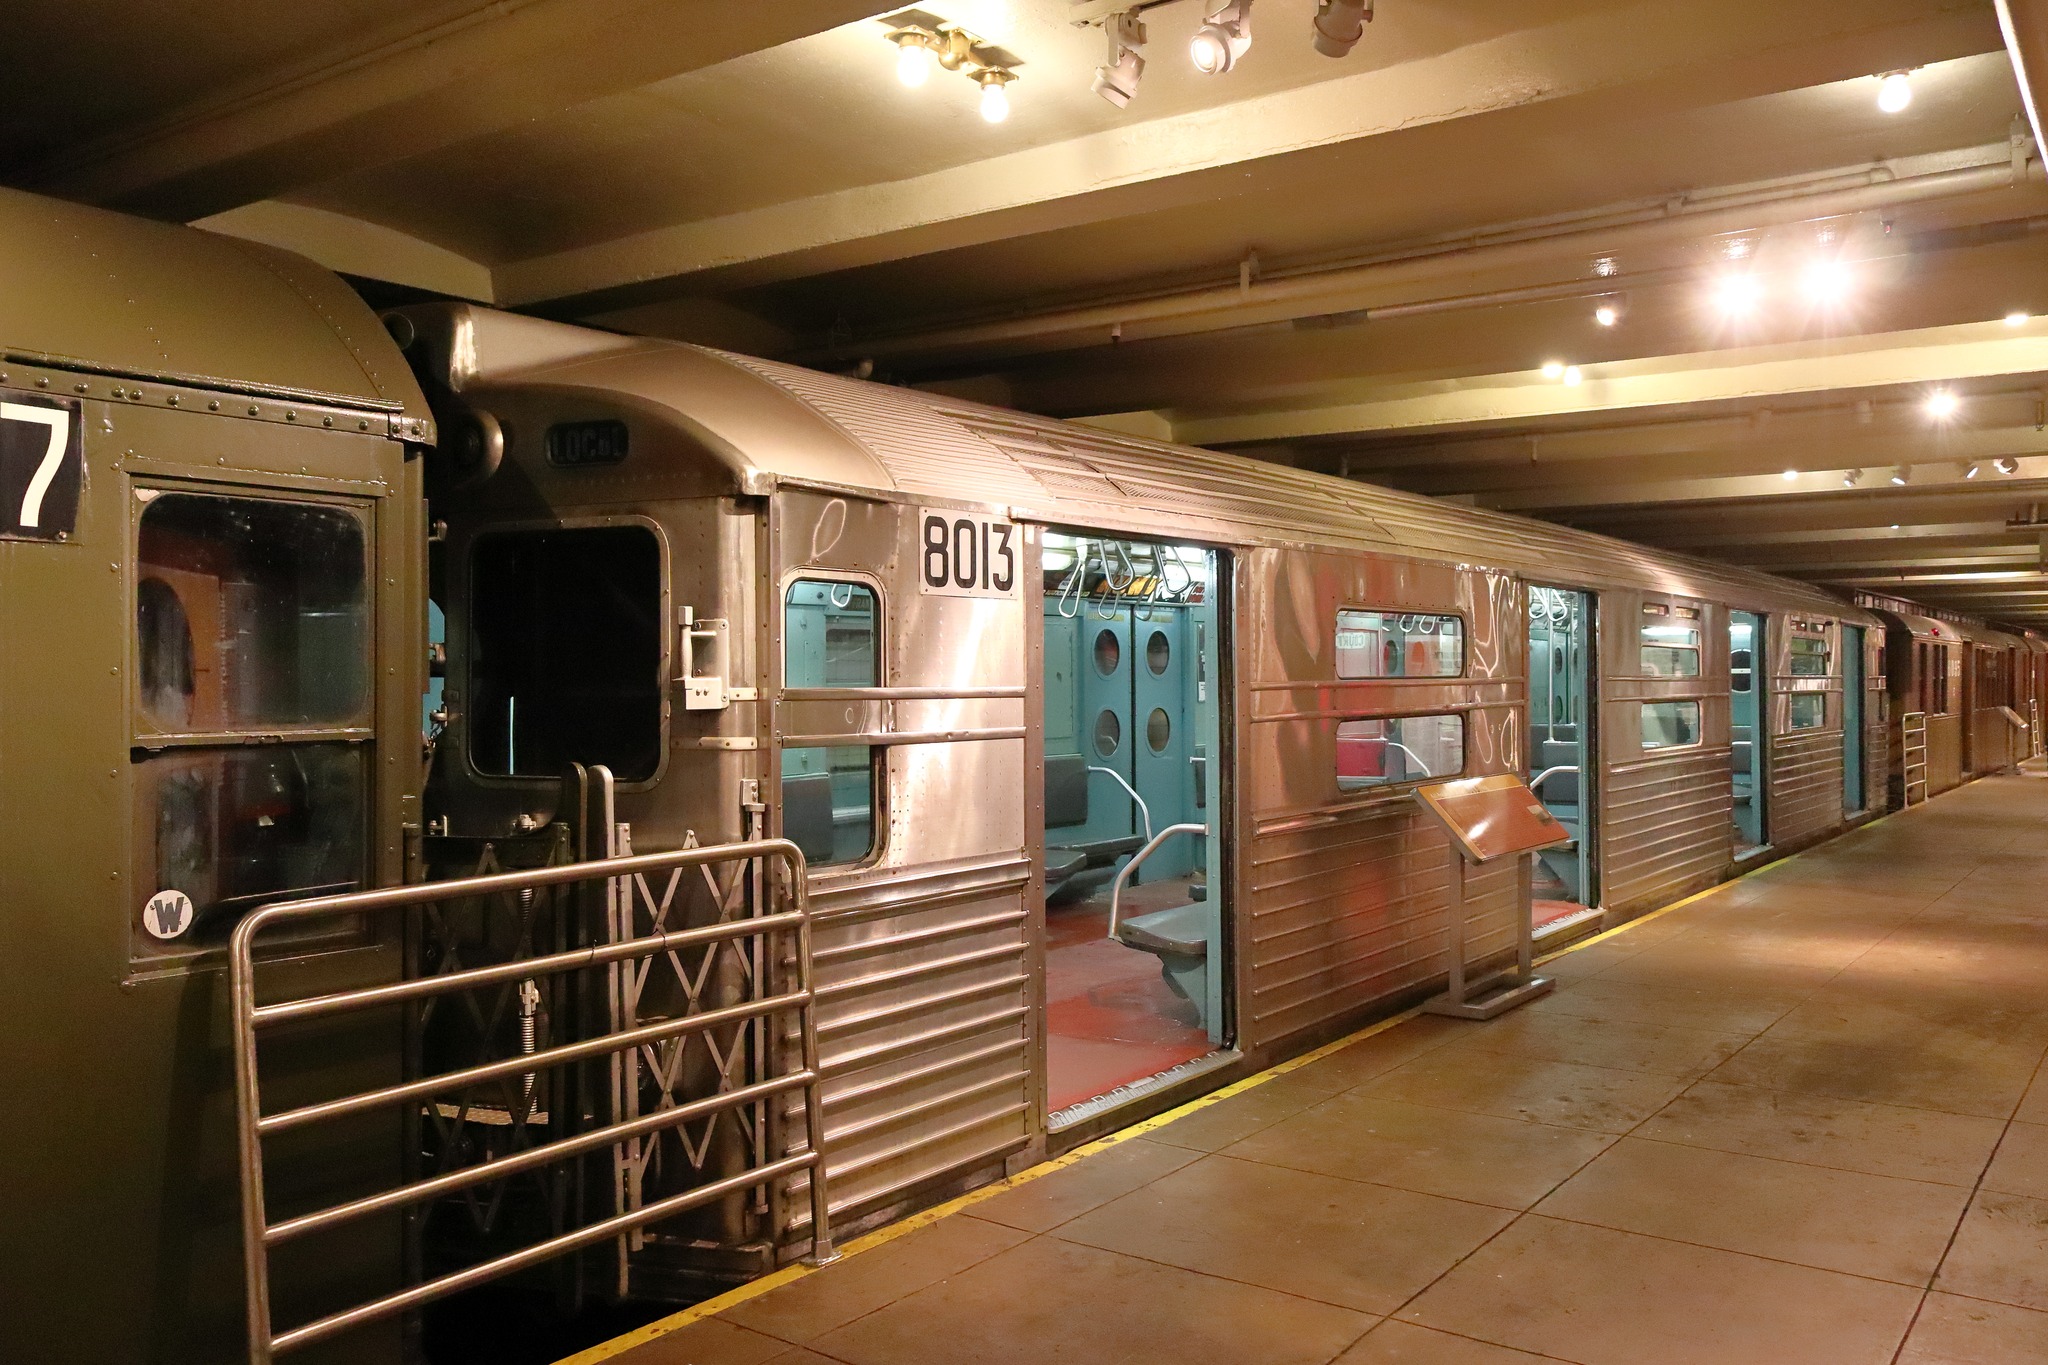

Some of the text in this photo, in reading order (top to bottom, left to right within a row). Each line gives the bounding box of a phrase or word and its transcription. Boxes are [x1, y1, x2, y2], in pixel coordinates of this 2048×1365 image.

[1, 402, 69, 527] 7
[924, 515, 1013, 591] 8013
[153, 896, 185, 935] W
